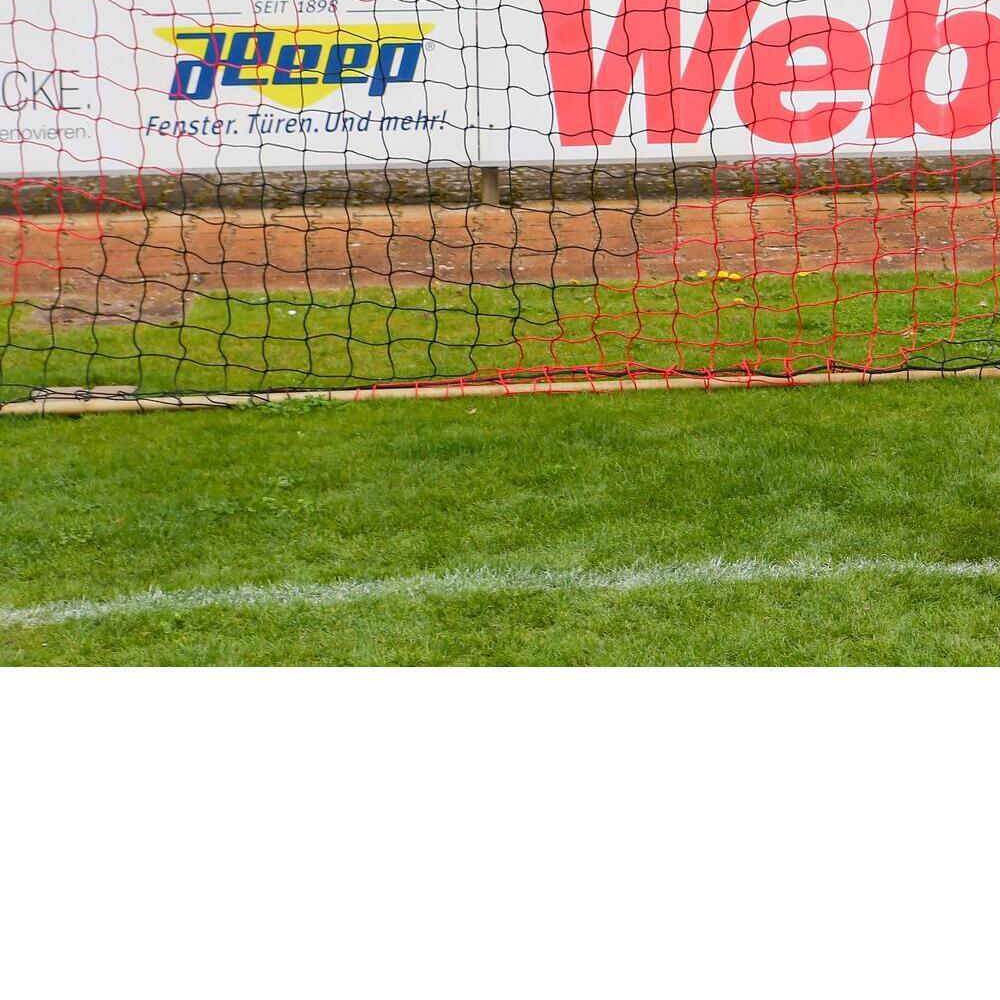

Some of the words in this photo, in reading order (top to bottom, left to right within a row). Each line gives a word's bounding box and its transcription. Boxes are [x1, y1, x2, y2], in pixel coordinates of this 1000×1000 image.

[254, 0, 289, 14] SEIT
[296, 0, 339, 14] 1898
[146, 115, 239, 136] Fenster.
[248, 113, 319, 135] Türen.
[325, 111, 372, 133] Und
[378, 110, 448, 132] mehr!
